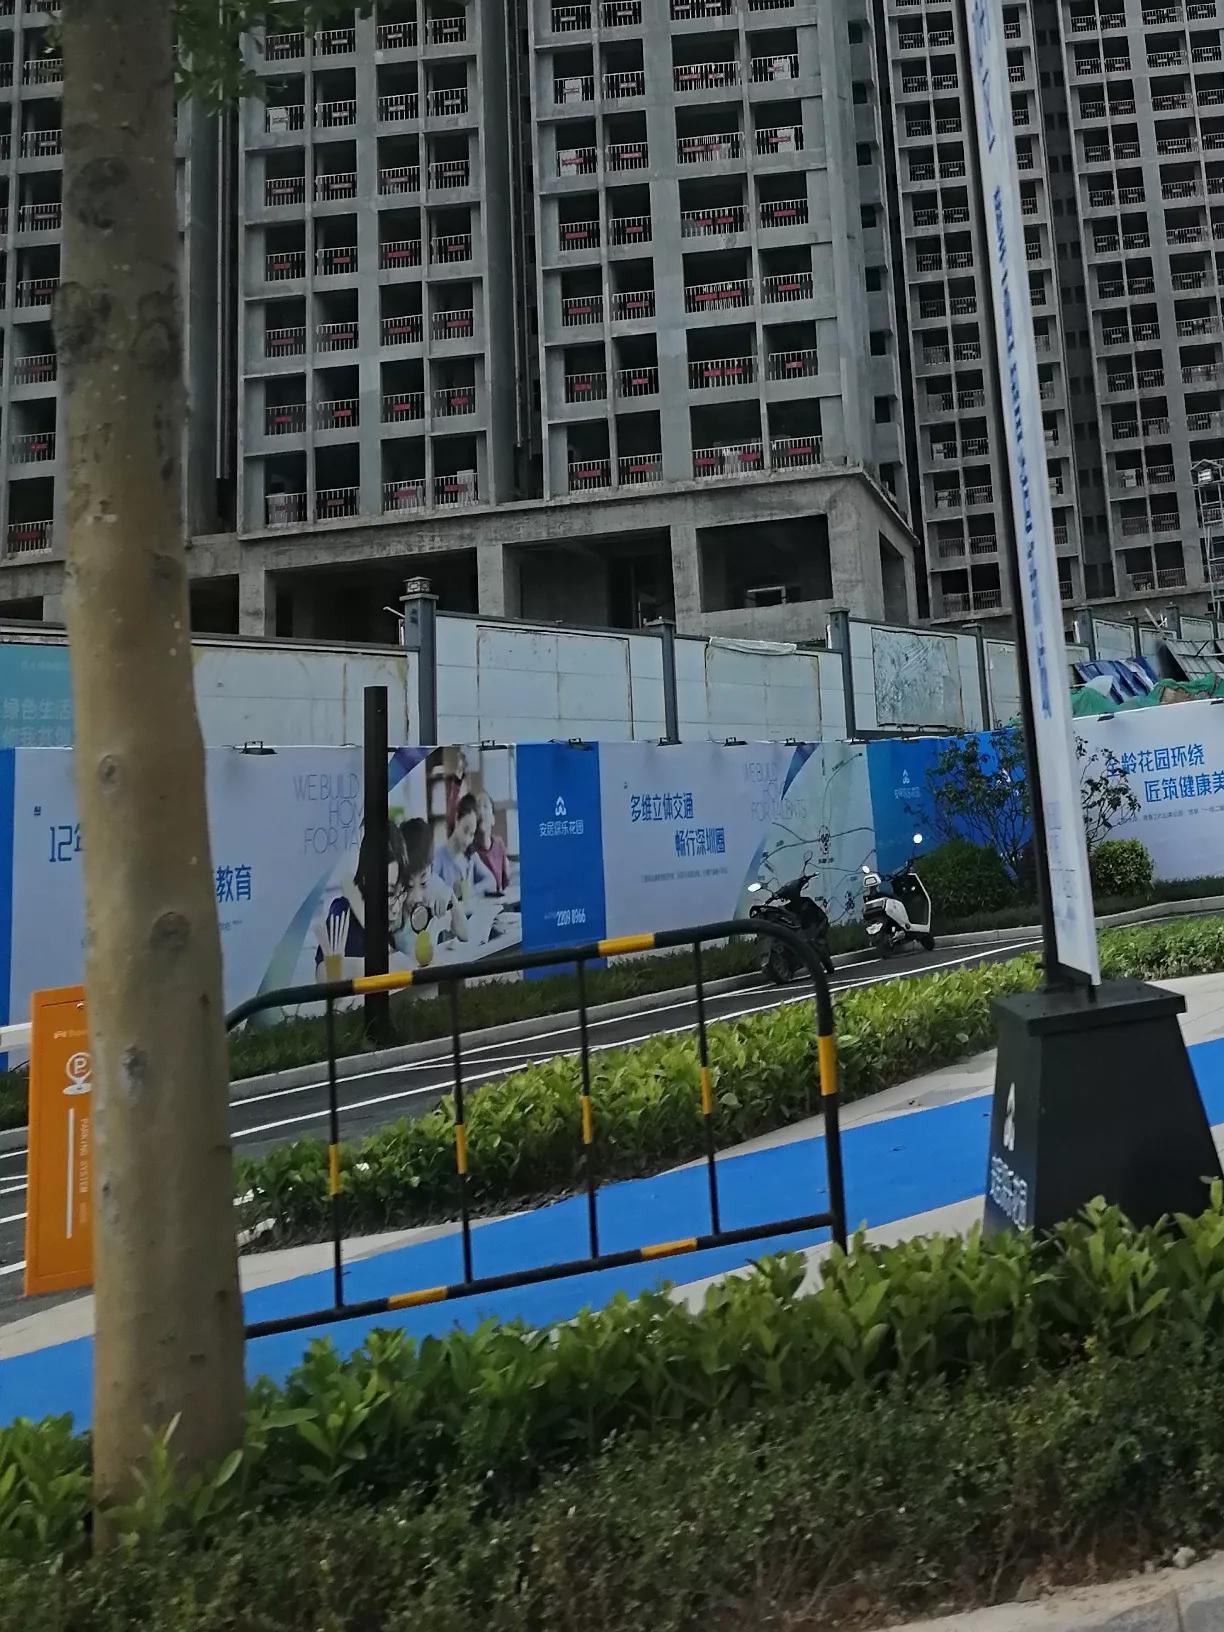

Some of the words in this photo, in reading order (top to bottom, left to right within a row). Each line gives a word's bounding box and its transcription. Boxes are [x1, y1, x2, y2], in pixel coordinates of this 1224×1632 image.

[630, 792, 694, 823] 多维立体交通
[674, 827, 726, 858] 畅行深圳圈
[215, 865, 252, 904] 教育
